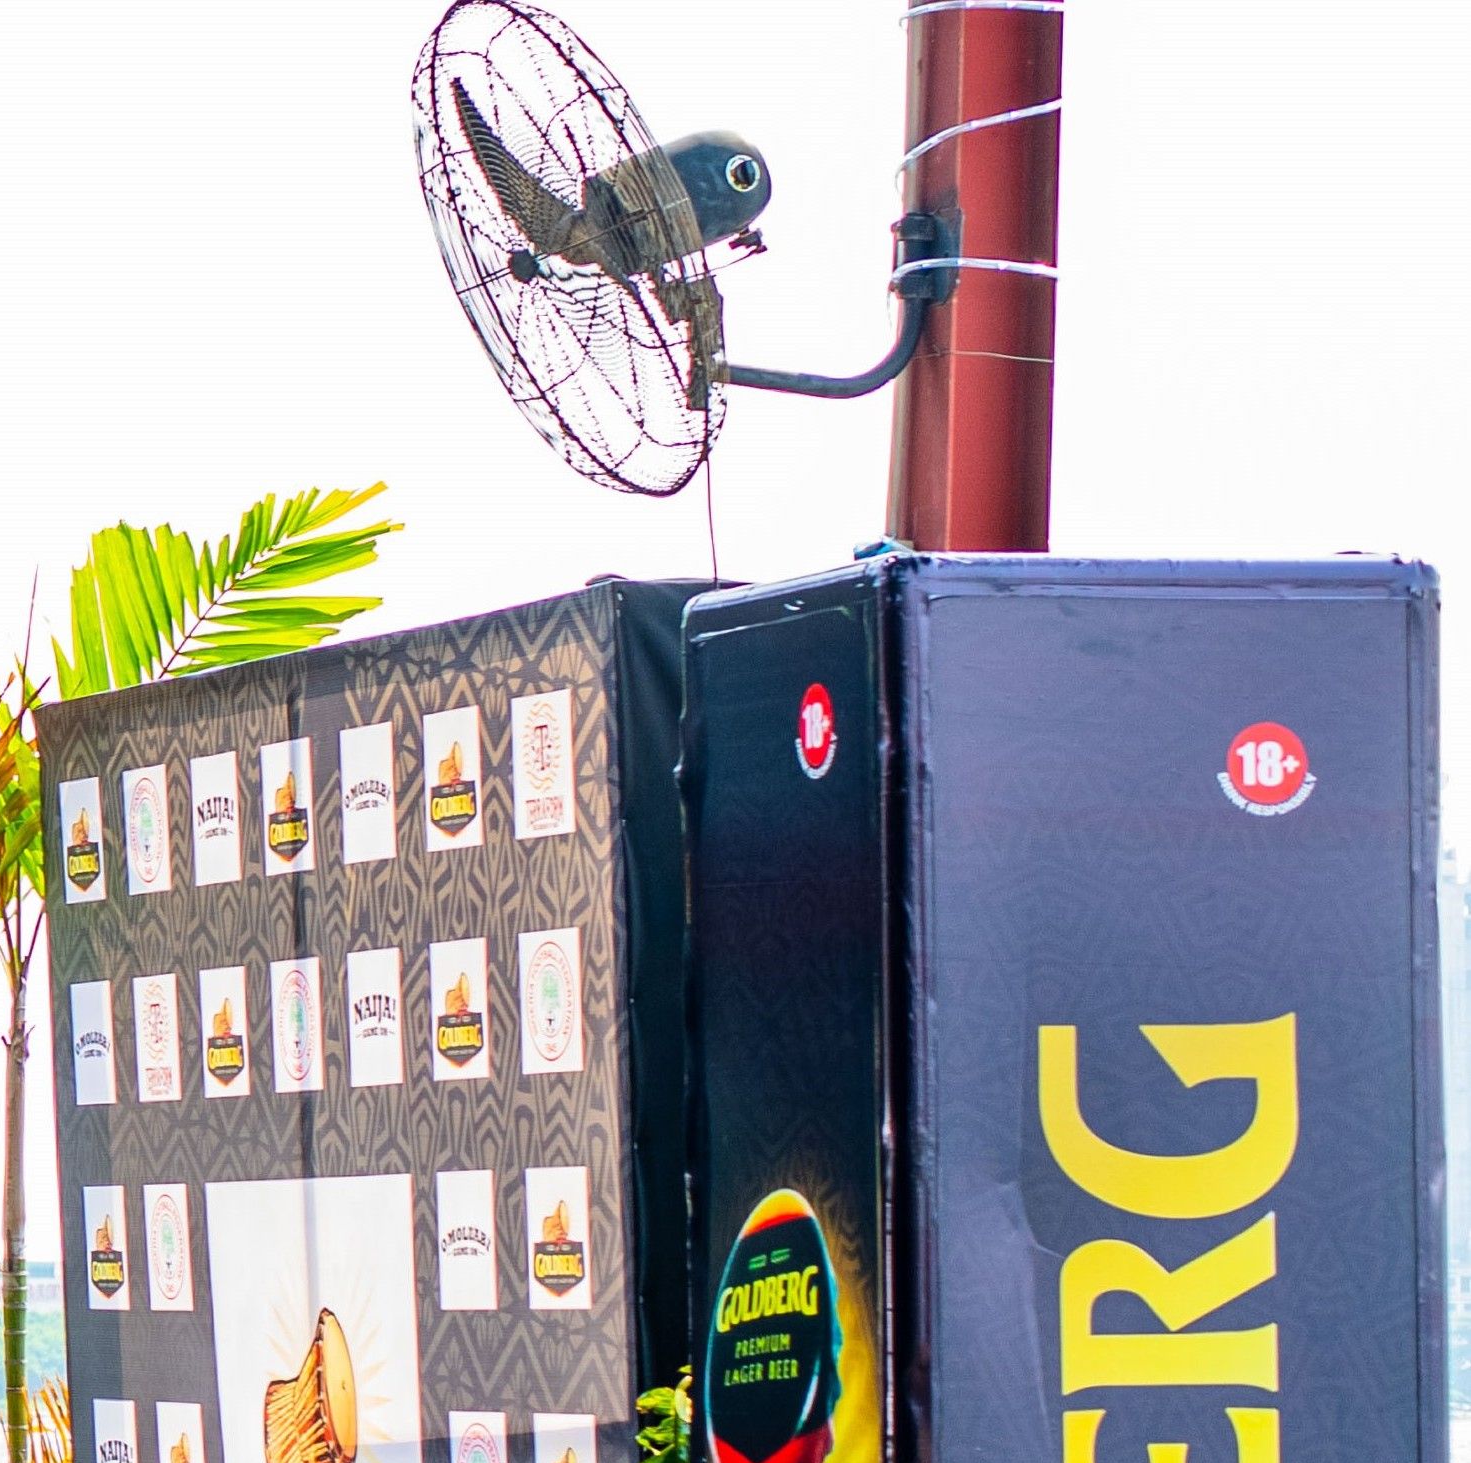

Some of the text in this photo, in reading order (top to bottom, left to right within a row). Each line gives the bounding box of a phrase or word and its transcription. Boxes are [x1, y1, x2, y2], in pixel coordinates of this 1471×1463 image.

[802, 702, 831, 749] 18+
[1236, 740, 1300, 788] 18+
[197, 797, 234, 826] NAIJA!
[354, 994, 396, 1024] NAIJA!
[716, 1265, 819, 1333] GOLDBERG
[735, 1333, 791, 1358] PREMIUM
[724, 1359, 799, 1386] LAGER BEER
